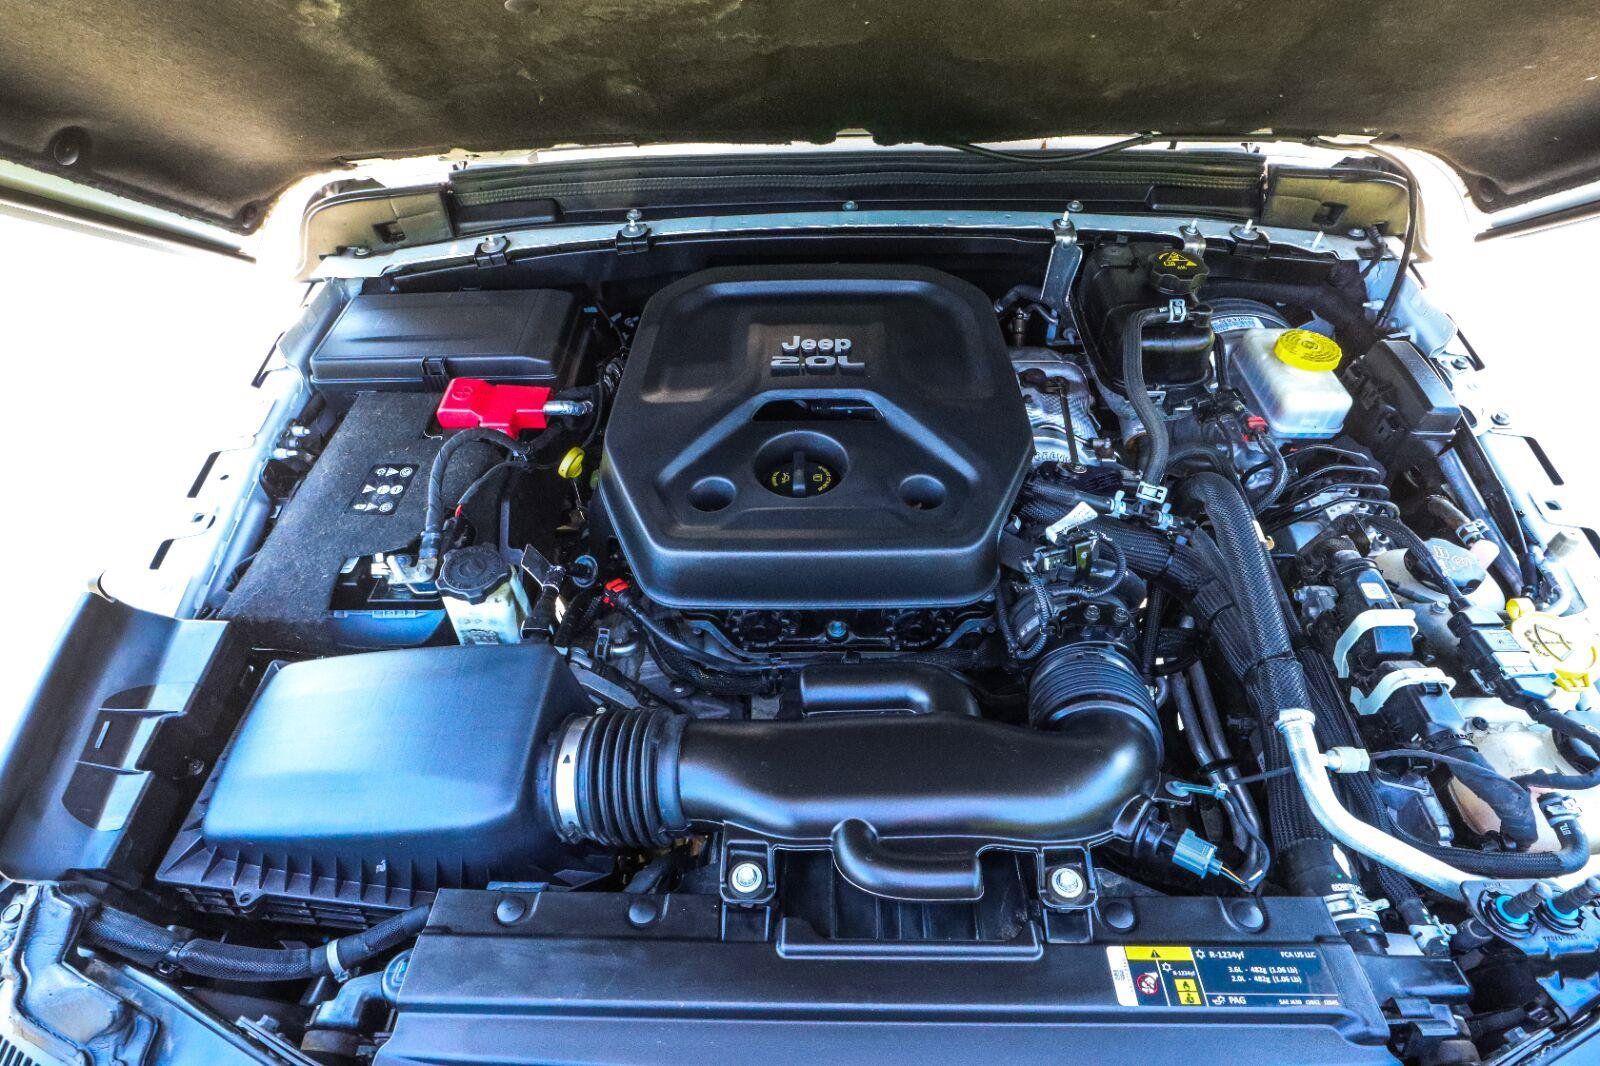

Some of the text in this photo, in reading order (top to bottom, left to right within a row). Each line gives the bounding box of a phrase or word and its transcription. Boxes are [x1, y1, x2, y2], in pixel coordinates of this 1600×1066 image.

[781, 335, 853, 354] Jeep
[770, 355, 865, 371] 2.0L
[1209, 951, 1244, 960] R-1234yf
[1229, 996, 1247, 1005] PAG
